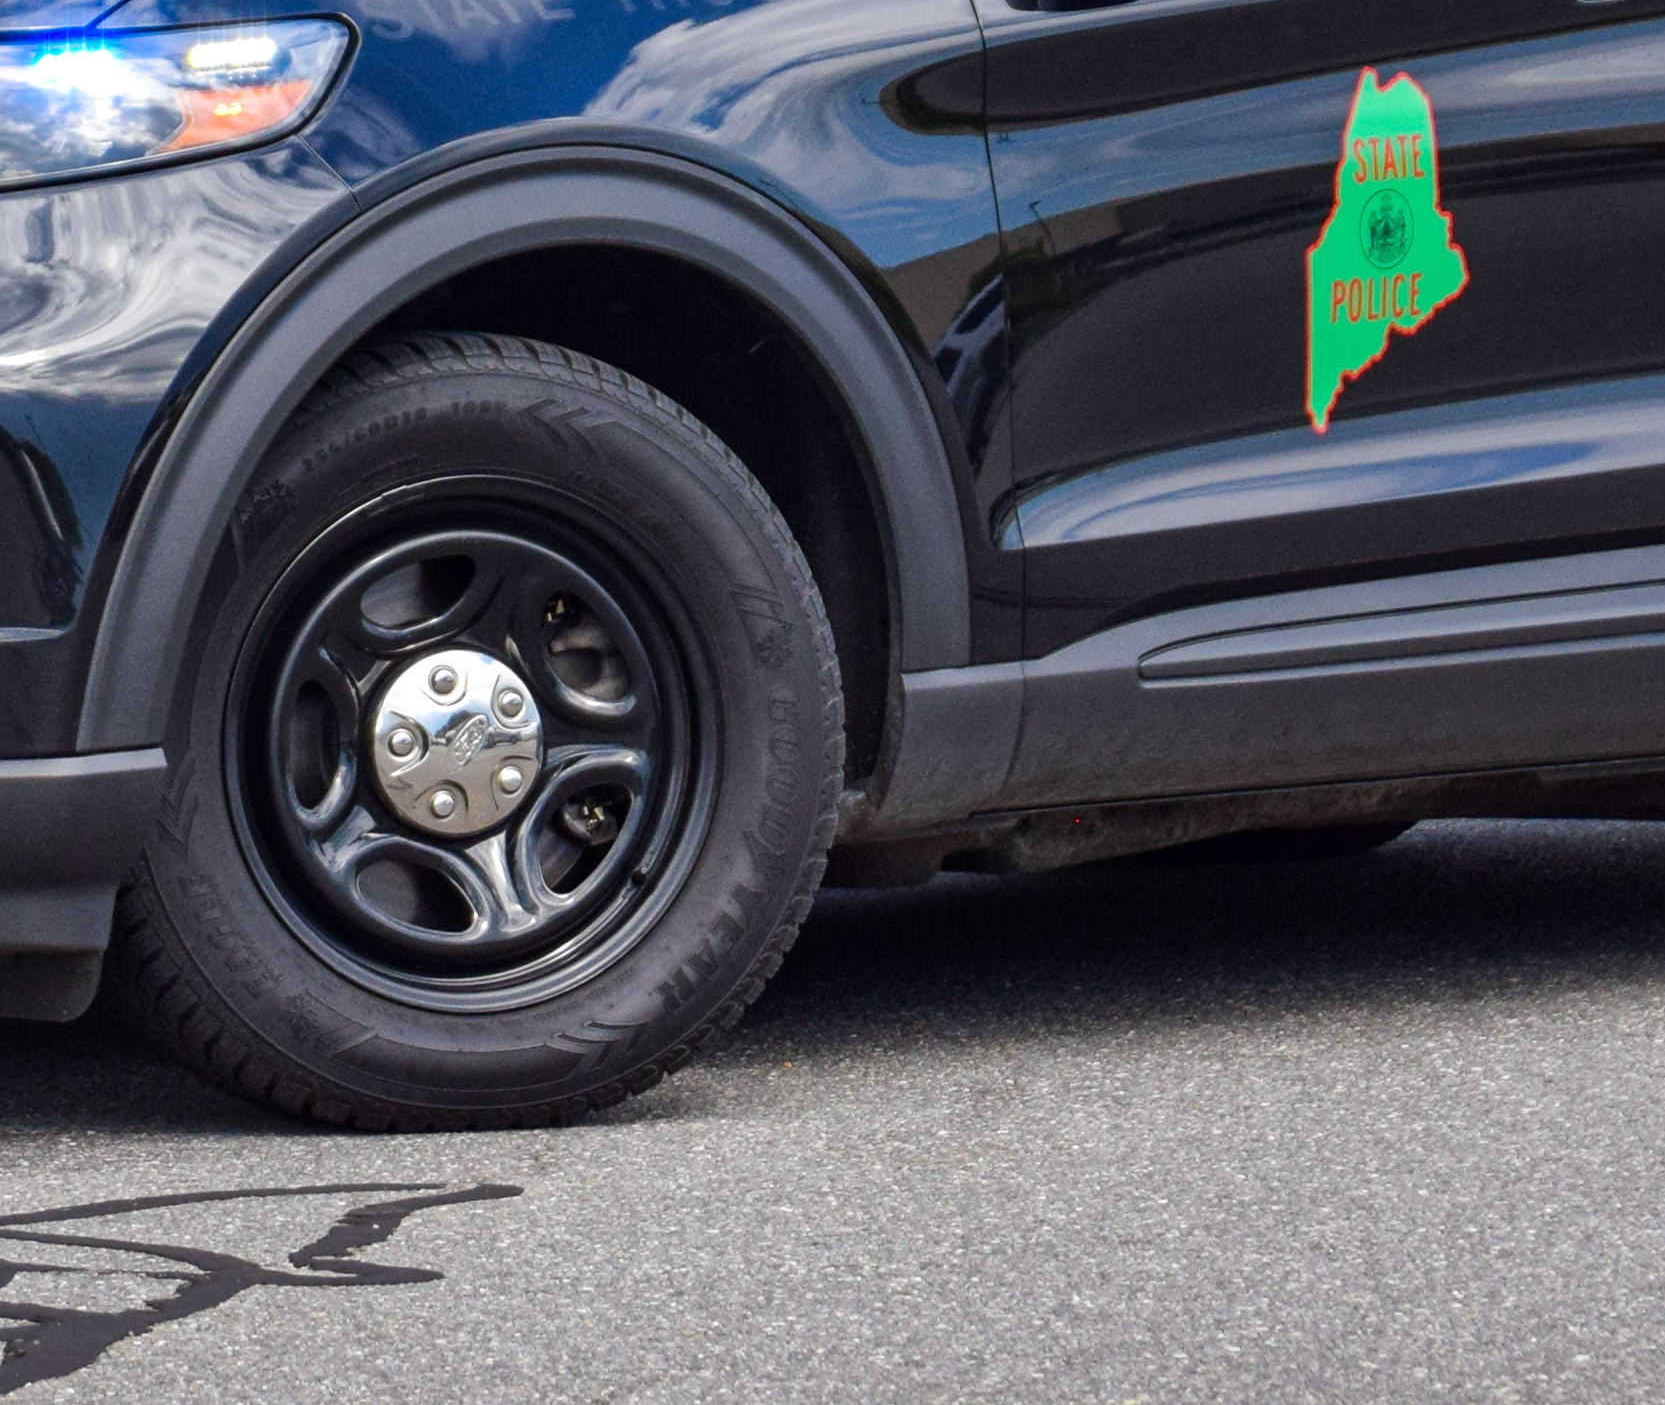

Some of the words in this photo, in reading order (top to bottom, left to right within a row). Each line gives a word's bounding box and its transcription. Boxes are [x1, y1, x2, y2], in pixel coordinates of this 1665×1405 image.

[1353, 133, 1426, 184] STATE
[1330, 272, 1423, 324] POLICE
[656, 682, 804, 1014] GOODYEAR
[178, 873, 285, 999] EAGLE
